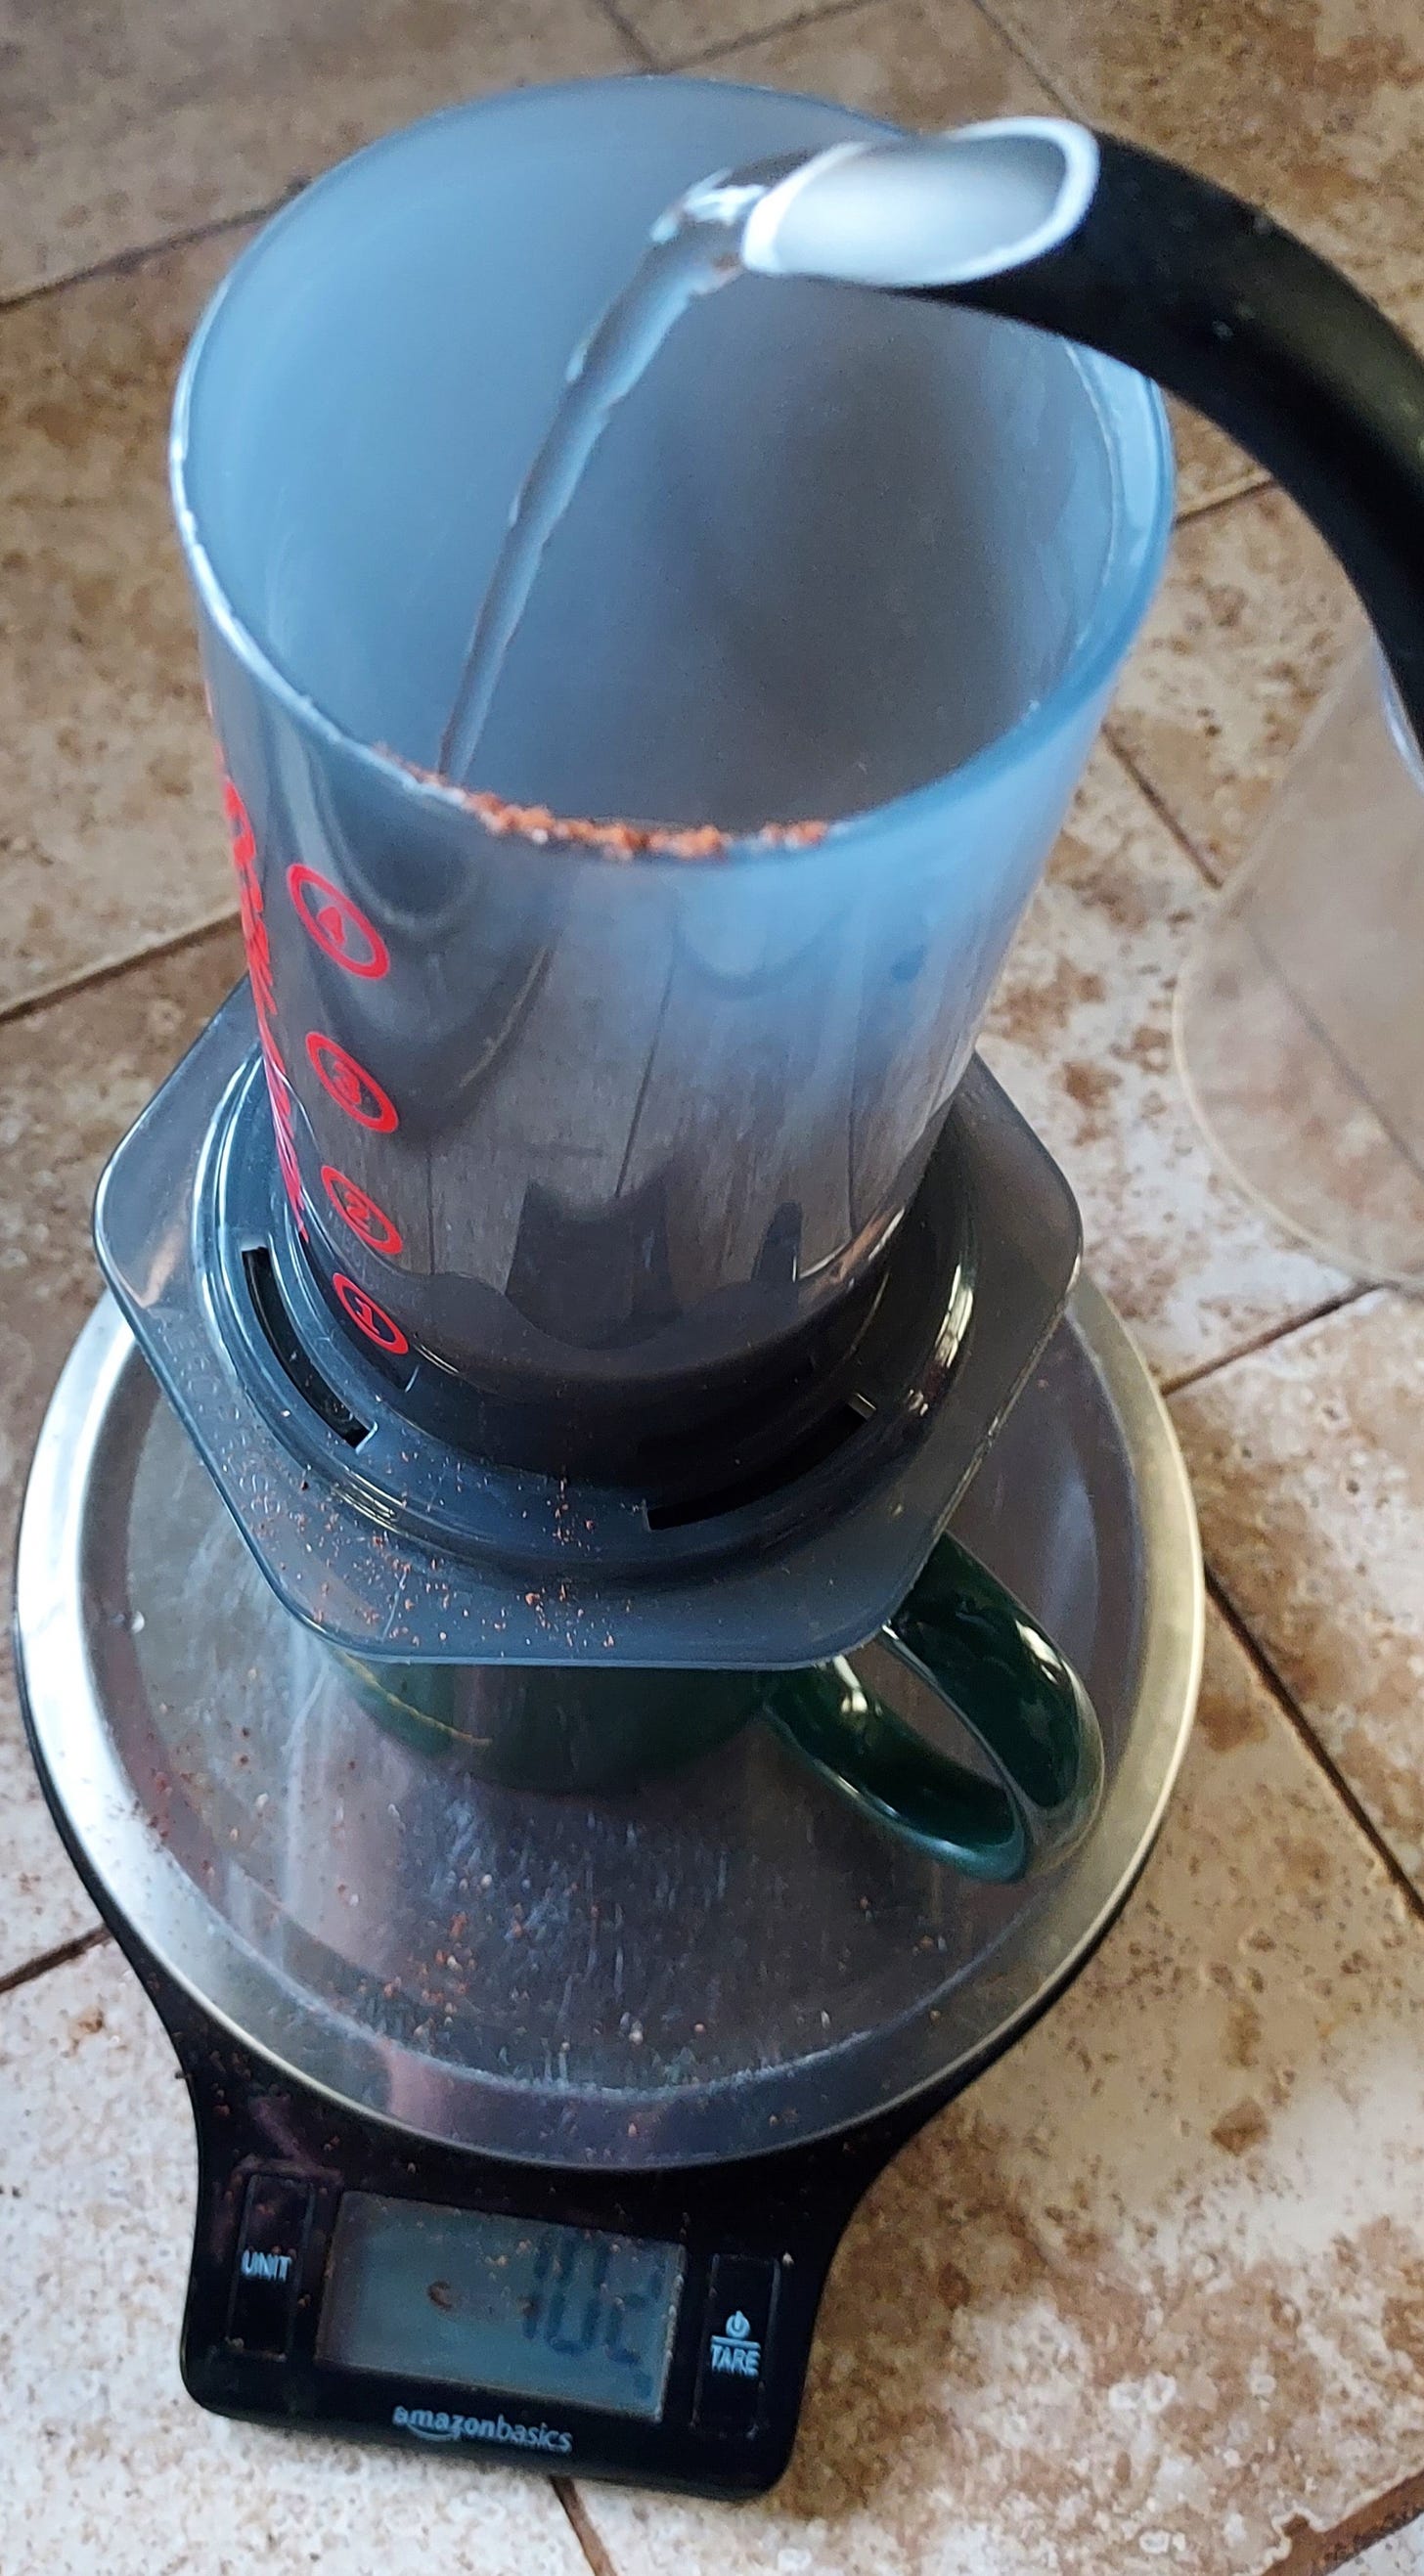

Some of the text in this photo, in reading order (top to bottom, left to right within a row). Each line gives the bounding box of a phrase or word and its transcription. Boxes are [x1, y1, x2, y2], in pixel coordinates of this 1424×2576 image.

[241, 2249, 292, 2282] UNIT
[522, 2229, 668, 2367] 102
[711, 2344, 761, 2377] TARE
[393, 2405, 573, 2454] amazonbasics
